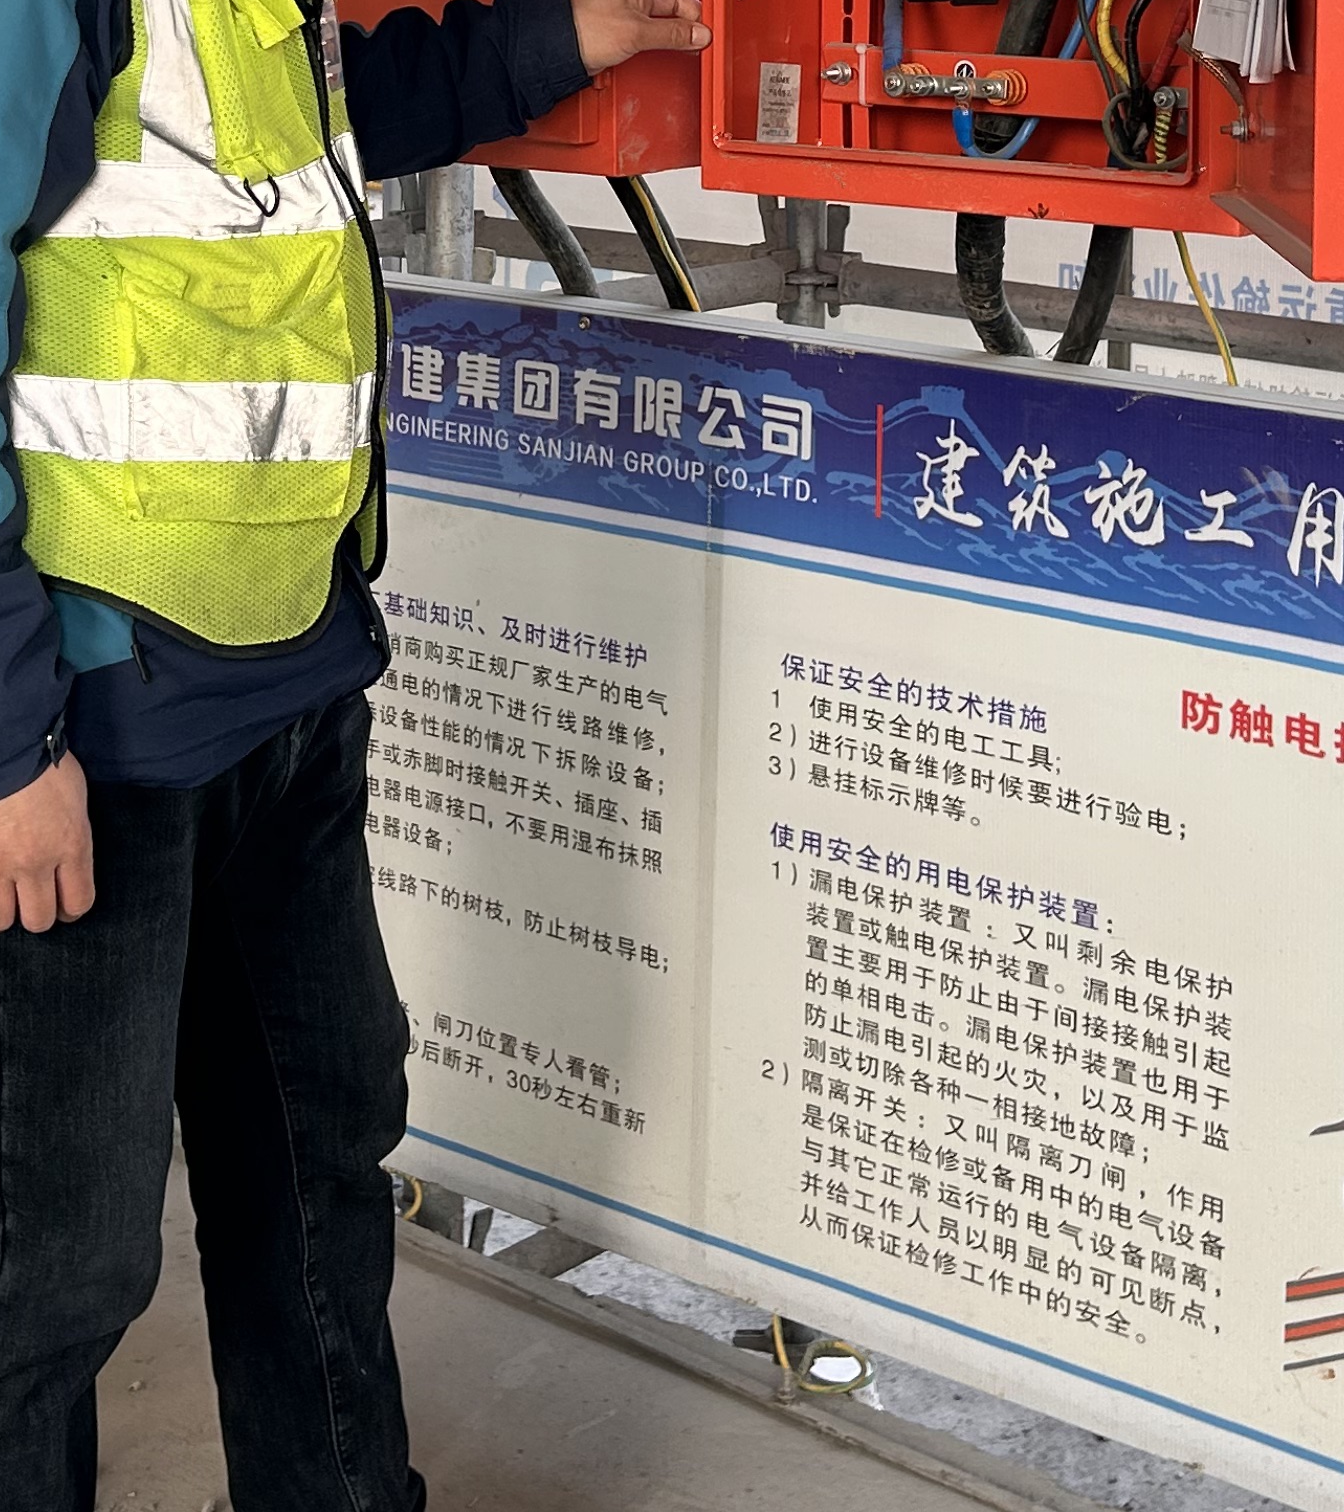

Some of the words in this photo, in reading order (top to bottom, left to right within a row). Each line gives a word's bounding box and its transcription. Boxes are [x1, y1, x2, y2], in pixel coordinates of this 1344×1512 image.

[401, 343, 813, 462] 建集团有限公司
[517, 433, 614, 470] SANJIAN
[623, 452, 705, 484] GROUP
[370, 590, 648, 669] 基础知识、及时进行维护
[780, 652, 1047, 734] 保证安全的技术措施
[373, 668, 666, 757] 通电的情况下进行线路维修，
[805, 970, 1231, 1110] 的单相电击。漏电保护装置也用于
[806, 902, 1233, 1041] 装置或触电保护装置。漏电保护装
[806, 934, 1231, 1078] 置主要用于防止由于间接接触引起
[804, 1002, 1230, 1152] 防止漏电引起的火灾，以及用于监
[802, 1103, 1226, 1262] 是保证在检修或备用中的电气设备
[799, 1203, 1148, 1346] 从而保证检修工作中的安全。
[800, 1171, 1221, 1335] 并给工作人员以明显的可见断点，
